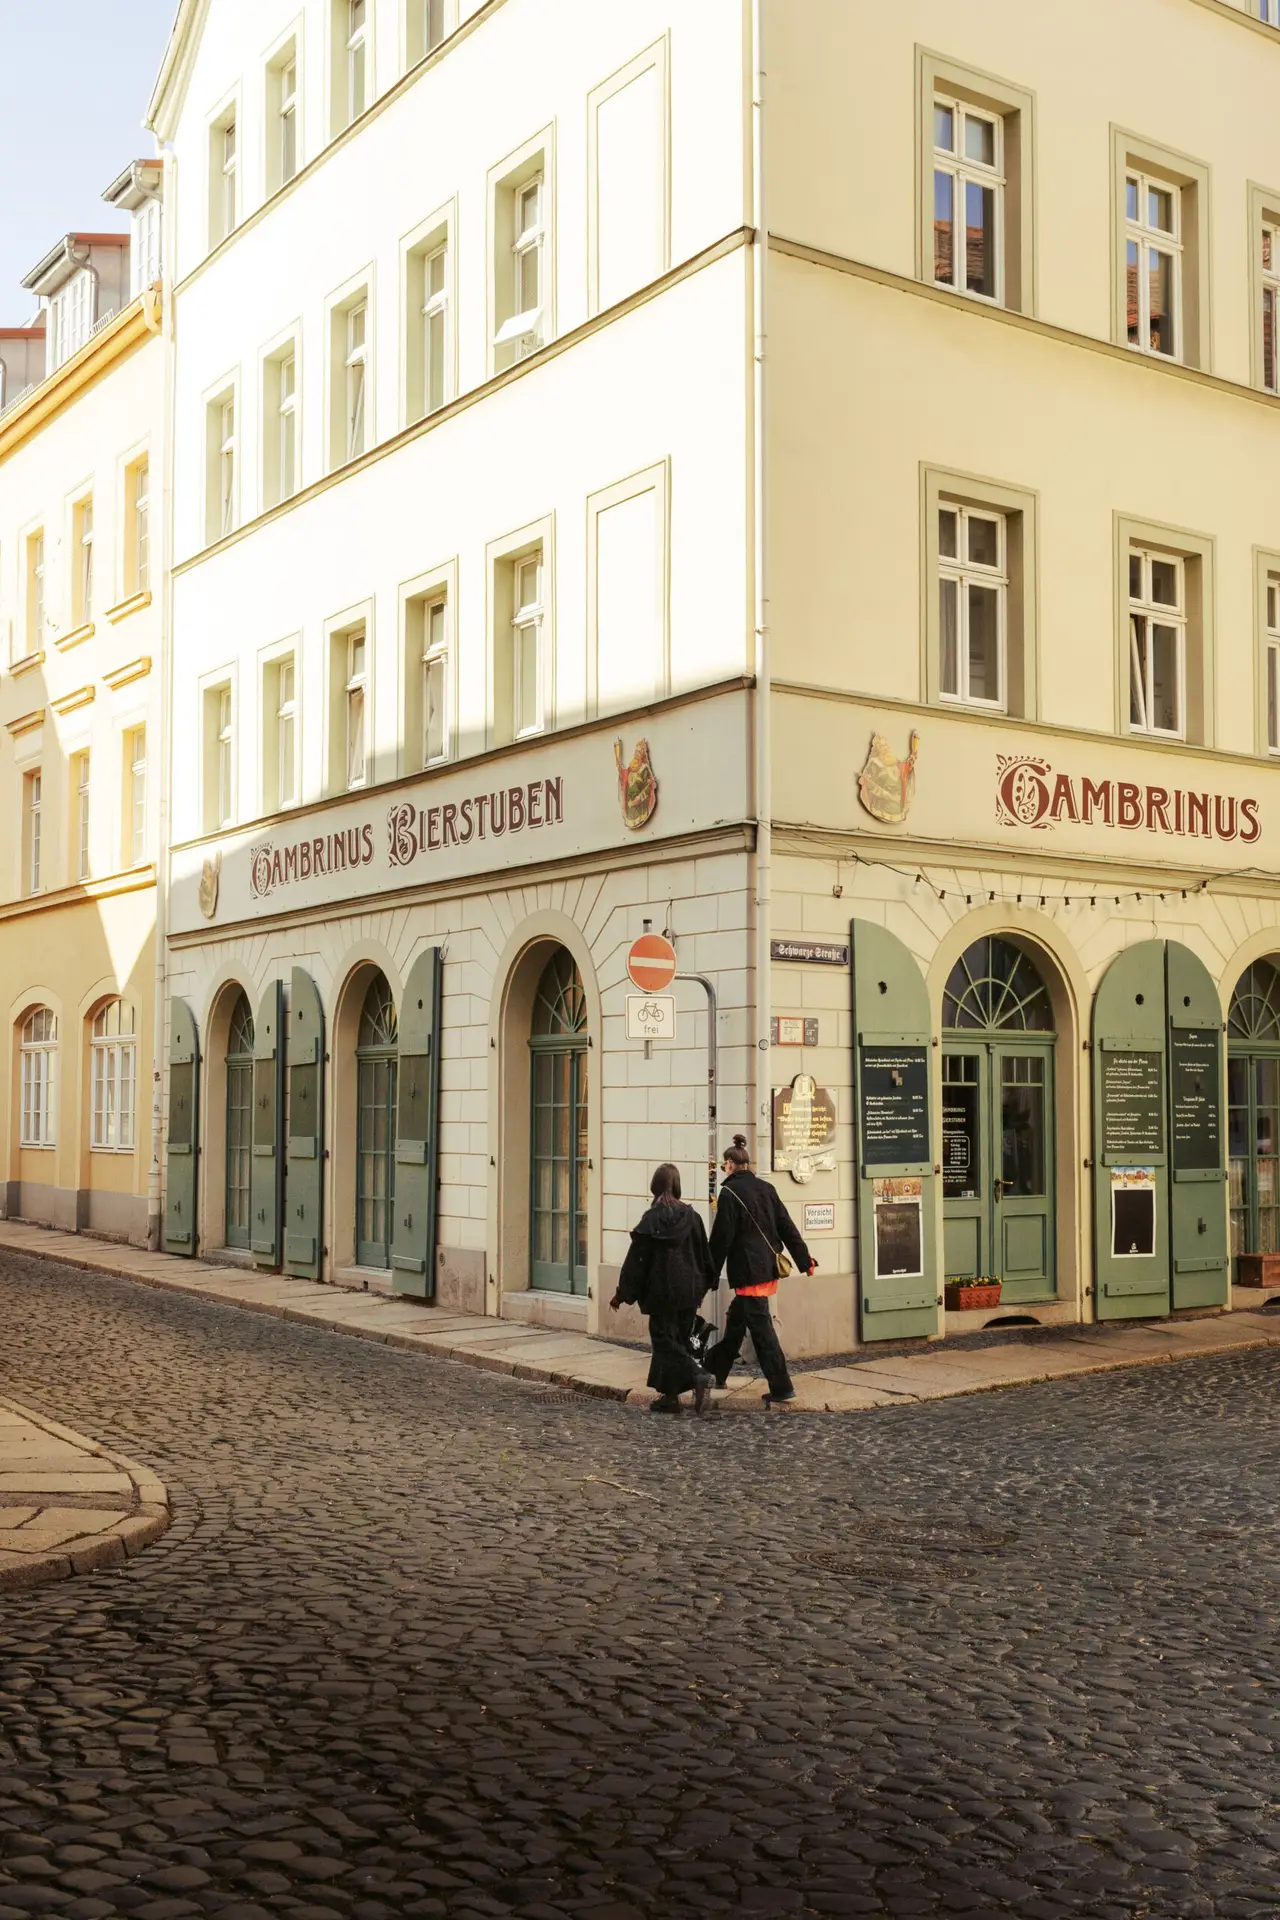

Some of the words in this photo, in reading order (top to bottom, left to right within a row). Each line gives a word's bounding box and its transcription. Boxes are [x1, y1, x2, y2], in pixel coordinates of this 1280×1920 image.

[995, 753, 1262, 843] GAMBRINUS
[249, 822, 375, 899] GAMBRINUS
[387, 775, 564, 868] BIERSTUBEN
[778, 944, 813, 959] Schwarze
[815, 947, 841, 961] Straße
[643, 1024, 660, 1034] frei
[806, 1207, 832, 1216] Vorsicht
